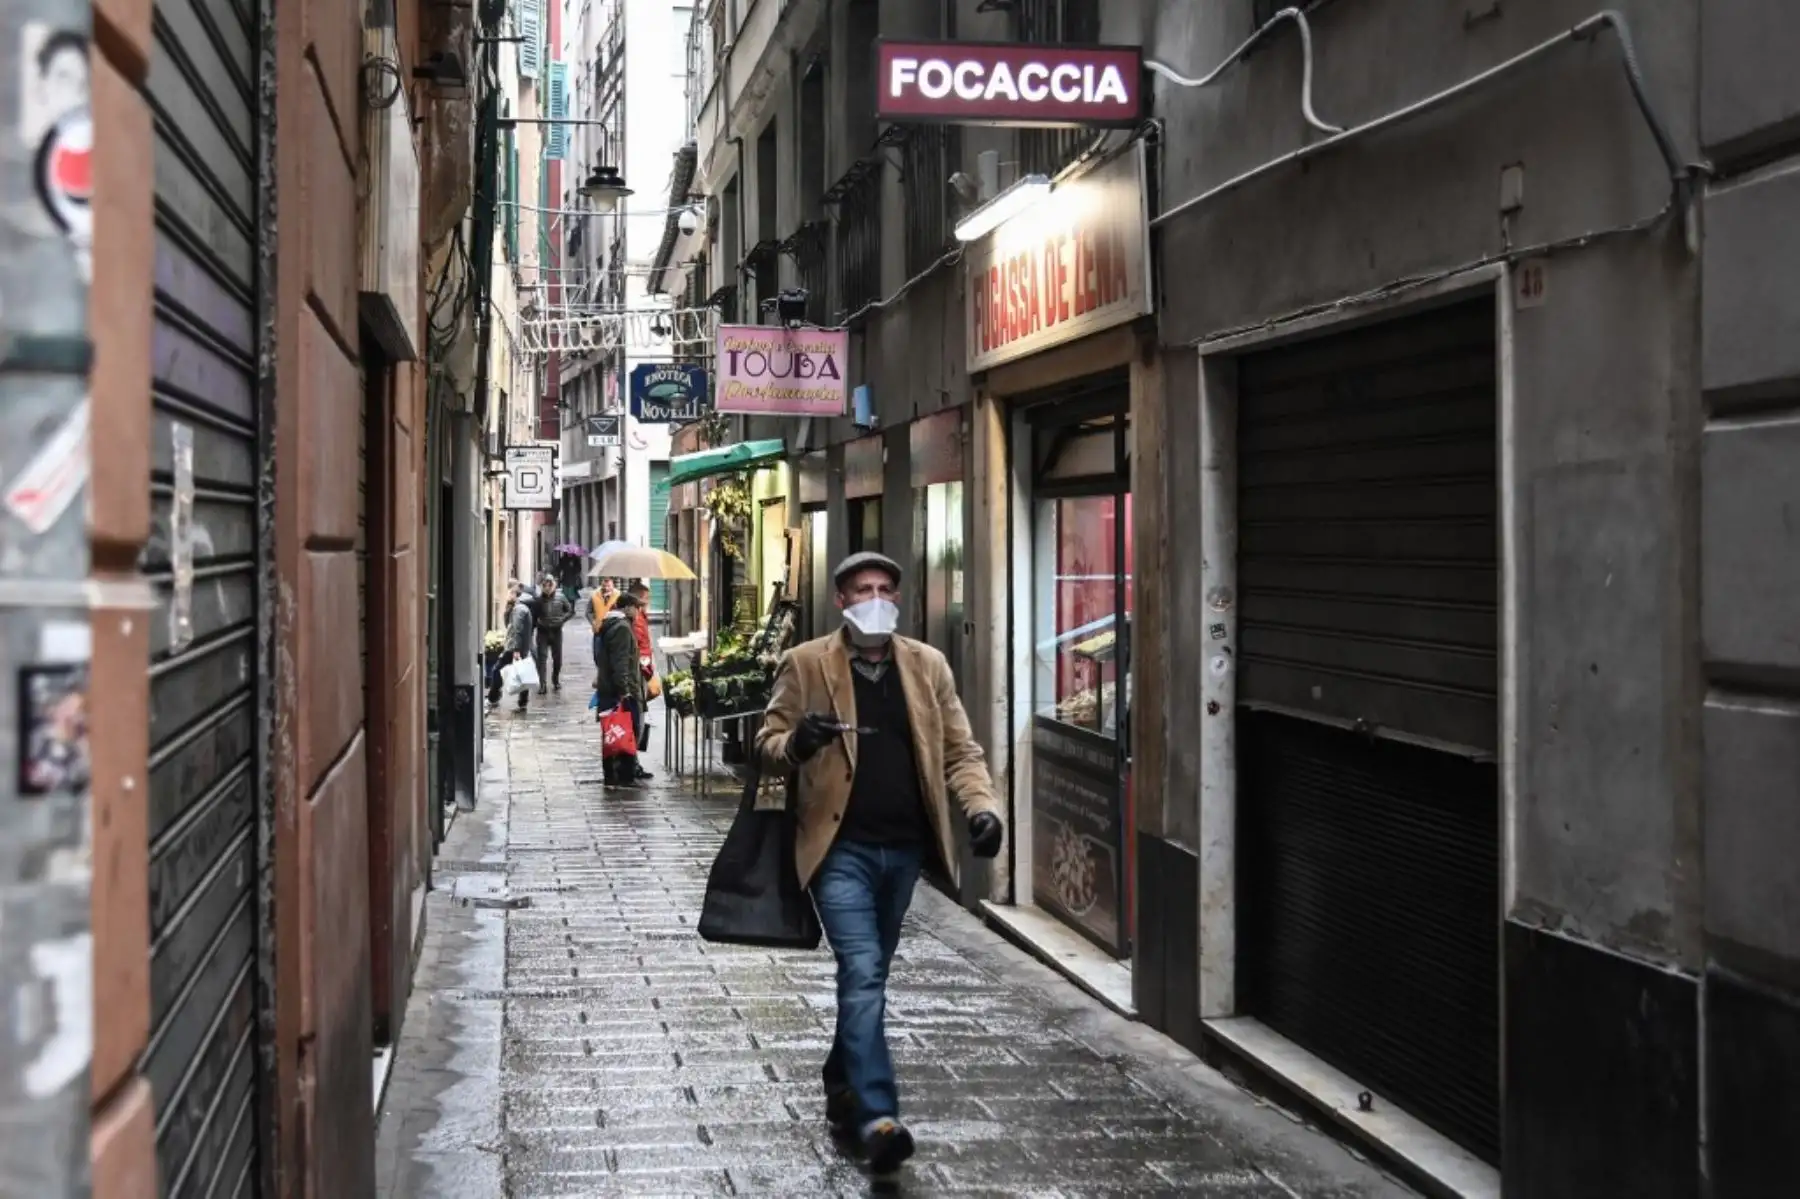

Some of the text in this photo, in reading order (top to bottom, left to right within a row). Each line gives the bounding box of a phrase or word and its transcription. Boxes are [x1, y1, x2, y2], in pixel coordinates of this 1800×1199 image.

[891, 58, 1128, 104] FOCACCIA
[973, 246, 1041, 356] FUGASSA
[1044, 234, 1070, 327] DE
[726, 349, 841, 380] TOUBA
[639, 396, 700, 419] NOVELLI
